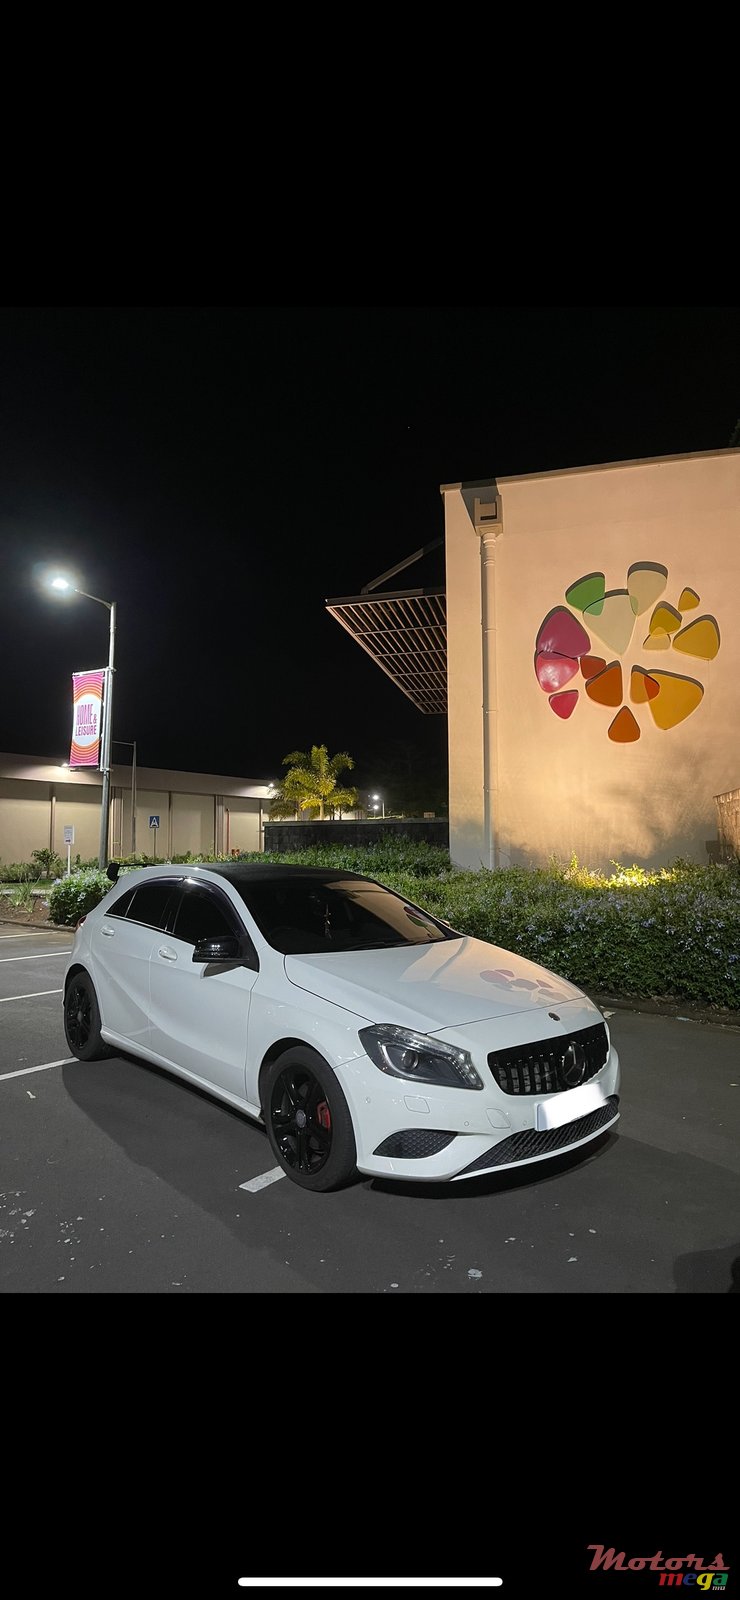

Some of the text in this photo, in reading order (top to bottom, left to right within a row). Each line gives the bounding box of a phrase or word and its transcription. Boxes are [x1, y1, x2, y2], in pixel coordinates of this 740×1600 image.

[77, 704, 97, 725] HOME &
[75, 725, 97, 736] LEISURE
[150, 816, 159, 827] A
